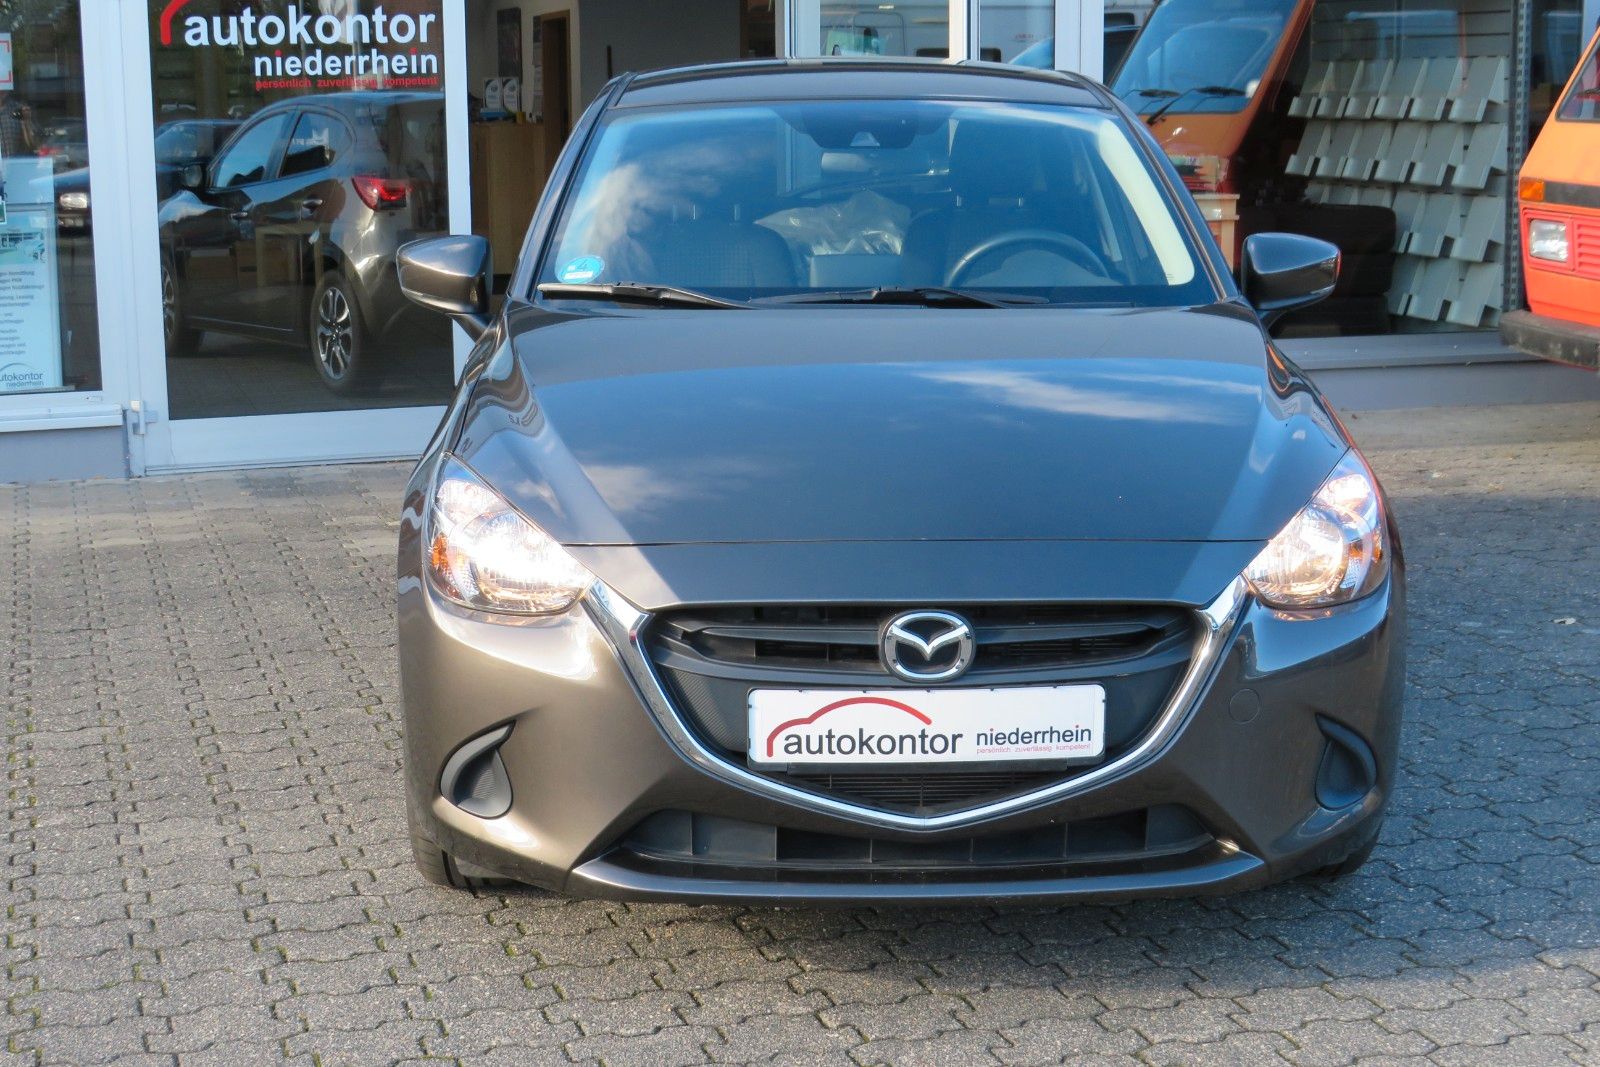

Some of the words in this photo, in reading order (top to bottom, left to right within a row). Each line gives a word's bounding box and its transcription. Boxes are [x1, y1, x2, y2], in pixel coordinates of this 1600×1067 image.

[184, 5, 436, 47] autokontor
[255, 48, 437, 76] niederrhein
[0, 373, 43, 381] utokontor
[783, 727, 963, 756] autokontor
[976, 724, 1092, 746] niederrhein
